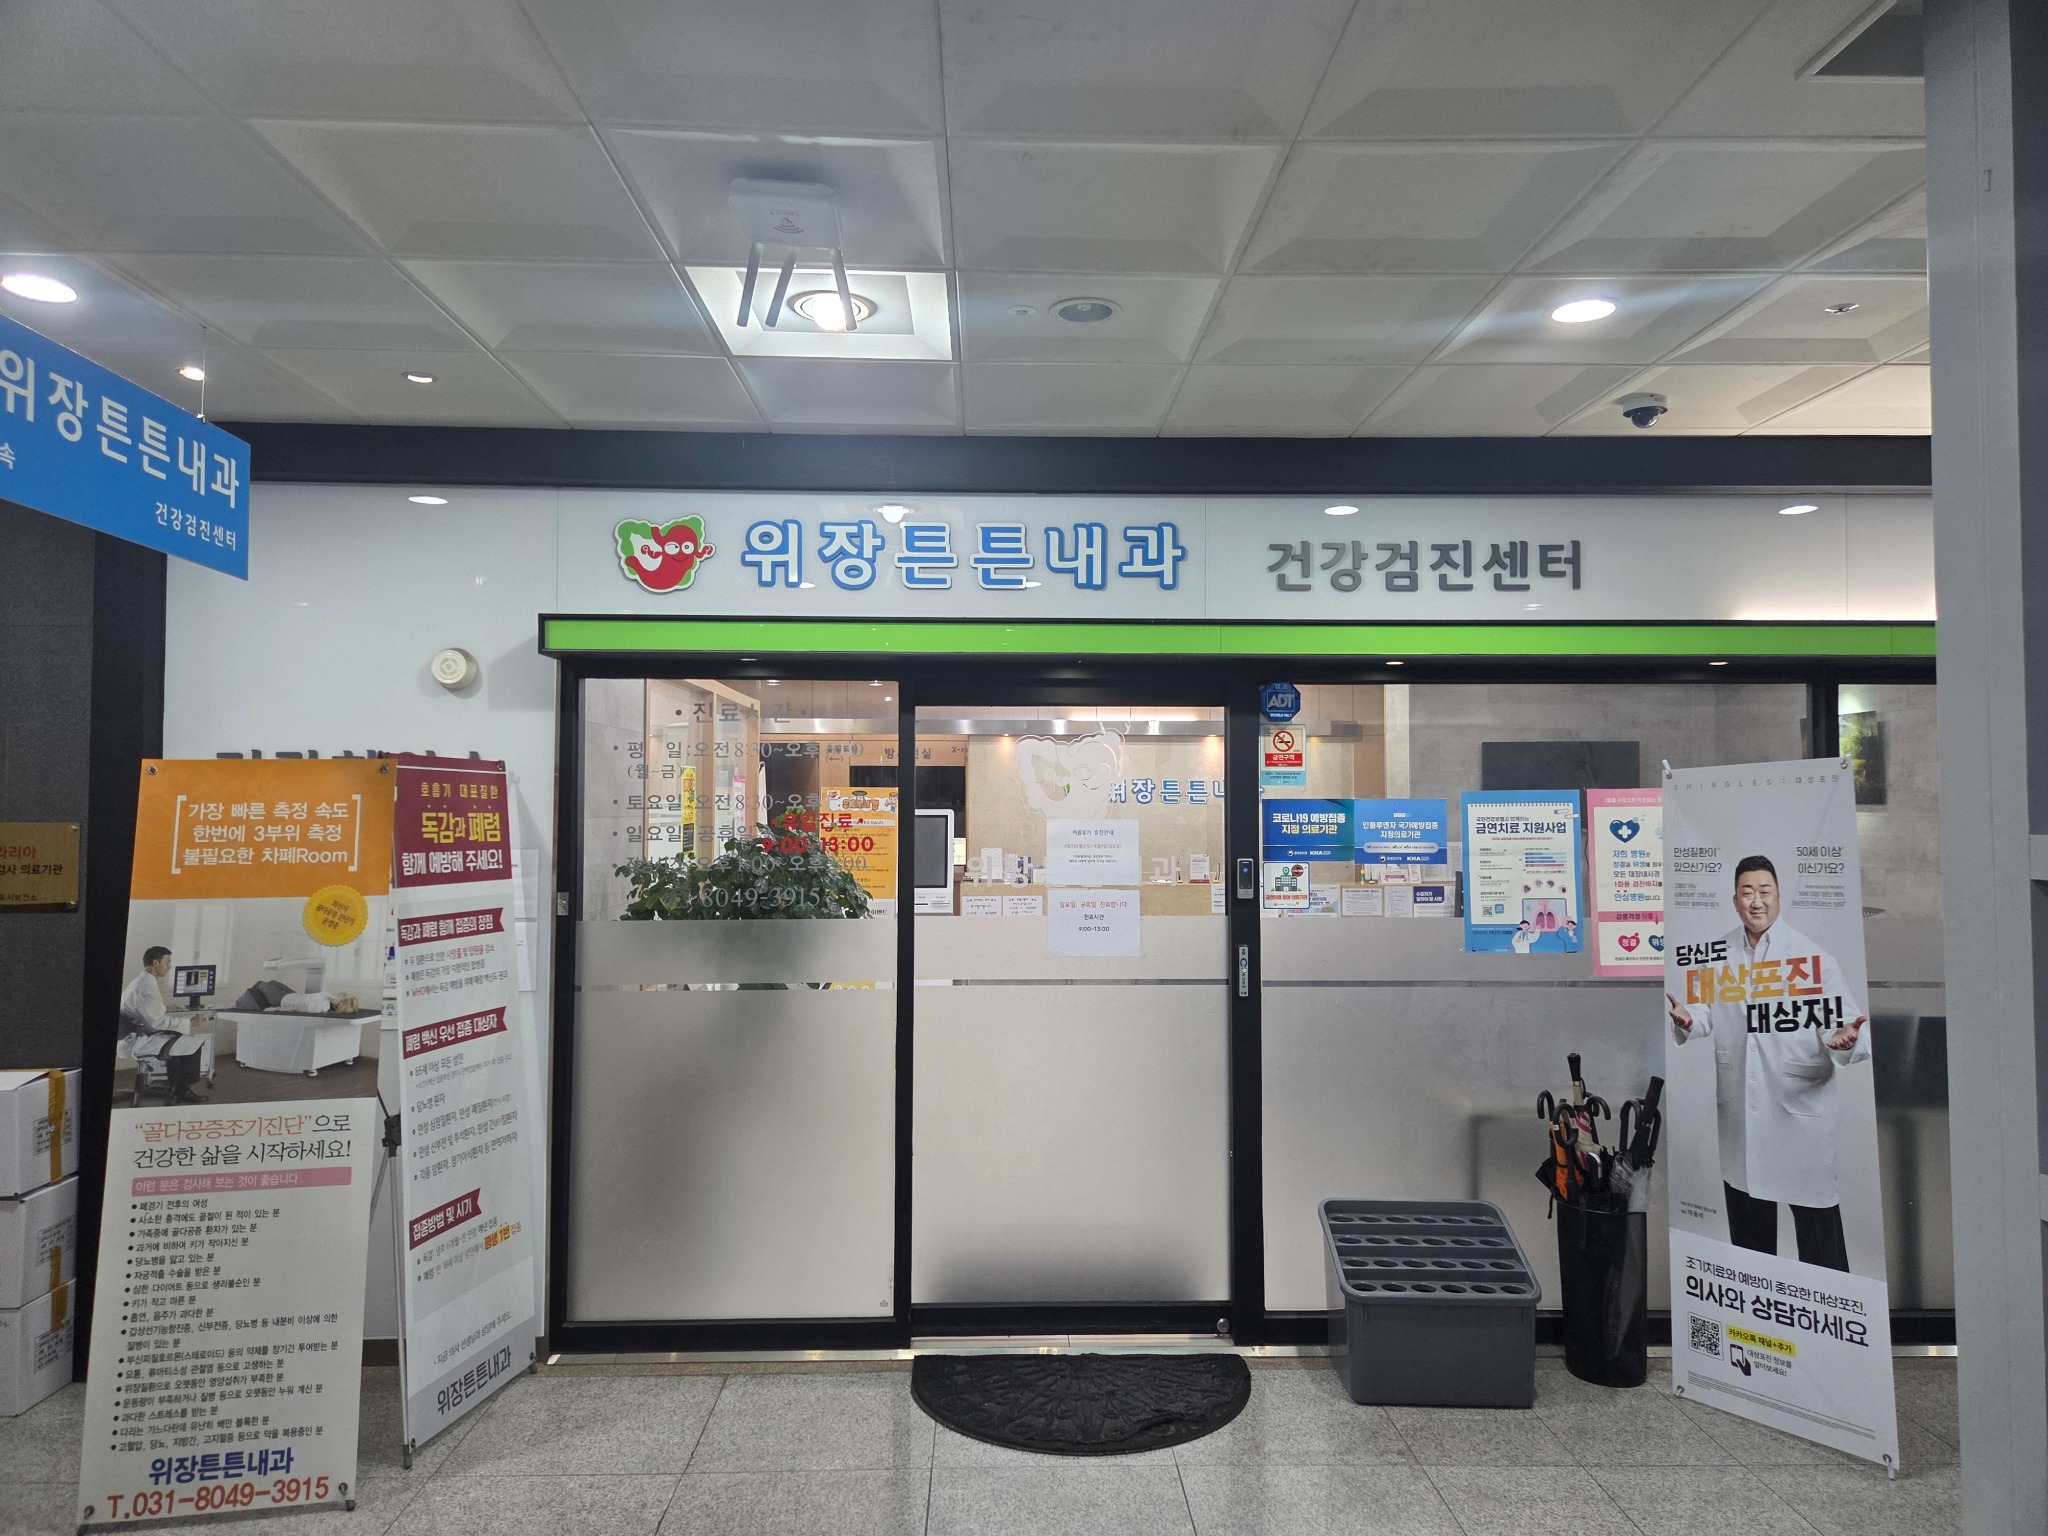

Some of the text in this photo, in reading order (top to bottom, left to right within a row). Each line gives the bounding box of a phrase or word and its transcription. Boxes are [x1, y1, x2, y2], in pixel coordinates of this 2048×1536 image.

[0, 350, 239, 508] 위장튼튼내과
[155, 502, 236, 551] 건강검진센터
[741, 519, 1187, 591] 위장튼튼내과
[1267, 540, 1582, 592] 건강검진센터
[1268, 694, 1295, 708] ADT
[692, 702, 793, 724] 진료시간
[627, 764, 683, 780] (월~금)
[420, 782, 499, 800] 호흡기 대표질환
[188, 801, 349, 820] 가장 빠른 측정 속도
[627, 794, 682, 811] 토요일
[421, 811, 501, 843] 독감과 폐렴
[783, 812, 853, 832] 휴일진료
[1272, 813, 1346, 823] 코로나19 예방접종
[1362, 821, 1438, 830] 인플루엔자 국가예방접종
[193, 824, 342, 843] 한번에 3부위 측정
[627, 825, 682, 843] 일요일
[1281, 824, 1338, 834] 지정 의료기관
[1380, 830, 1421, 839] 지정의료기관
[1475, 821, 1567, 834] 금연치료 지원사업
[182, 846, 348, 865] 불필요한 차폐Room
[1630, 849, 1651, 858] 병원은
[1673, 847, 1717, 857] 만성질환이
[1796, 846, 1818, 857] 50세
[20, 864, 63, 875] 의료기관
[402, 848, 503, 877] 함께 예방해 주세요!
[1673, 862, 1723, 873] 있으신가요?
[1797, 862, 1845, 874] 이신가요?
[1613, 870, 1660, 878] 모든 대장내시경
[701, 886, 820, 908] 8049-3915
[478, 914, 494, 930] 장점
[1675, 940, 1728, 967] 당신도
[1686, 955, 1824, 1005] 대상포진
[1747, 996, 1844, 1034] 대상자!
[405, 1013, 498, 1052] 폐렴 백신 우선 접종 대상자
[132, 1140, 352, 1169] 건강한 삶을 시작하세요!
[136, 1172, 298, 1193] 이런 분은 검사해 보는 것이 좋습니다
[167, 1199, 189, 1209] 전후의
[192, 1198, 208, 1209] 여성
[137, 1208, 280, 1225] 사소한 충격에도 골절이 된 적이 있는 분
[413, 1198, 472, 1241] 접종방법 및 시기
[137, 1223, 258, 1239] 가족중에 골다공증 환자가 있는 분
[135, 1237, 250, 1252] 과거에 비하여 키가 작아지신 분
[135, 1252, 215, 1267] 당뇨병을 앓고 있는 분
[1686, 1256, 1737, 1282] 조기치료와
[1738, 1271, 1774, 1292] 예방이
[1774, 1280, 1812, 1300] 중요한
[1686, 1274, 1870, 1348] 의사와 상담하세요
[1728, 1327, 1757, 1344] 카카오톡
[1747, 1349, 1792, 1369] 대상포진 정보를
[1753, 1360, 1788, 1377] 알아보세요!
[437, 1345, 512, 1416] 위장튼튼내과
[149, 1446, 294, 1486] 위장튼튼내과
[106, 1475, 330, 1520] T.031-8049-3915
